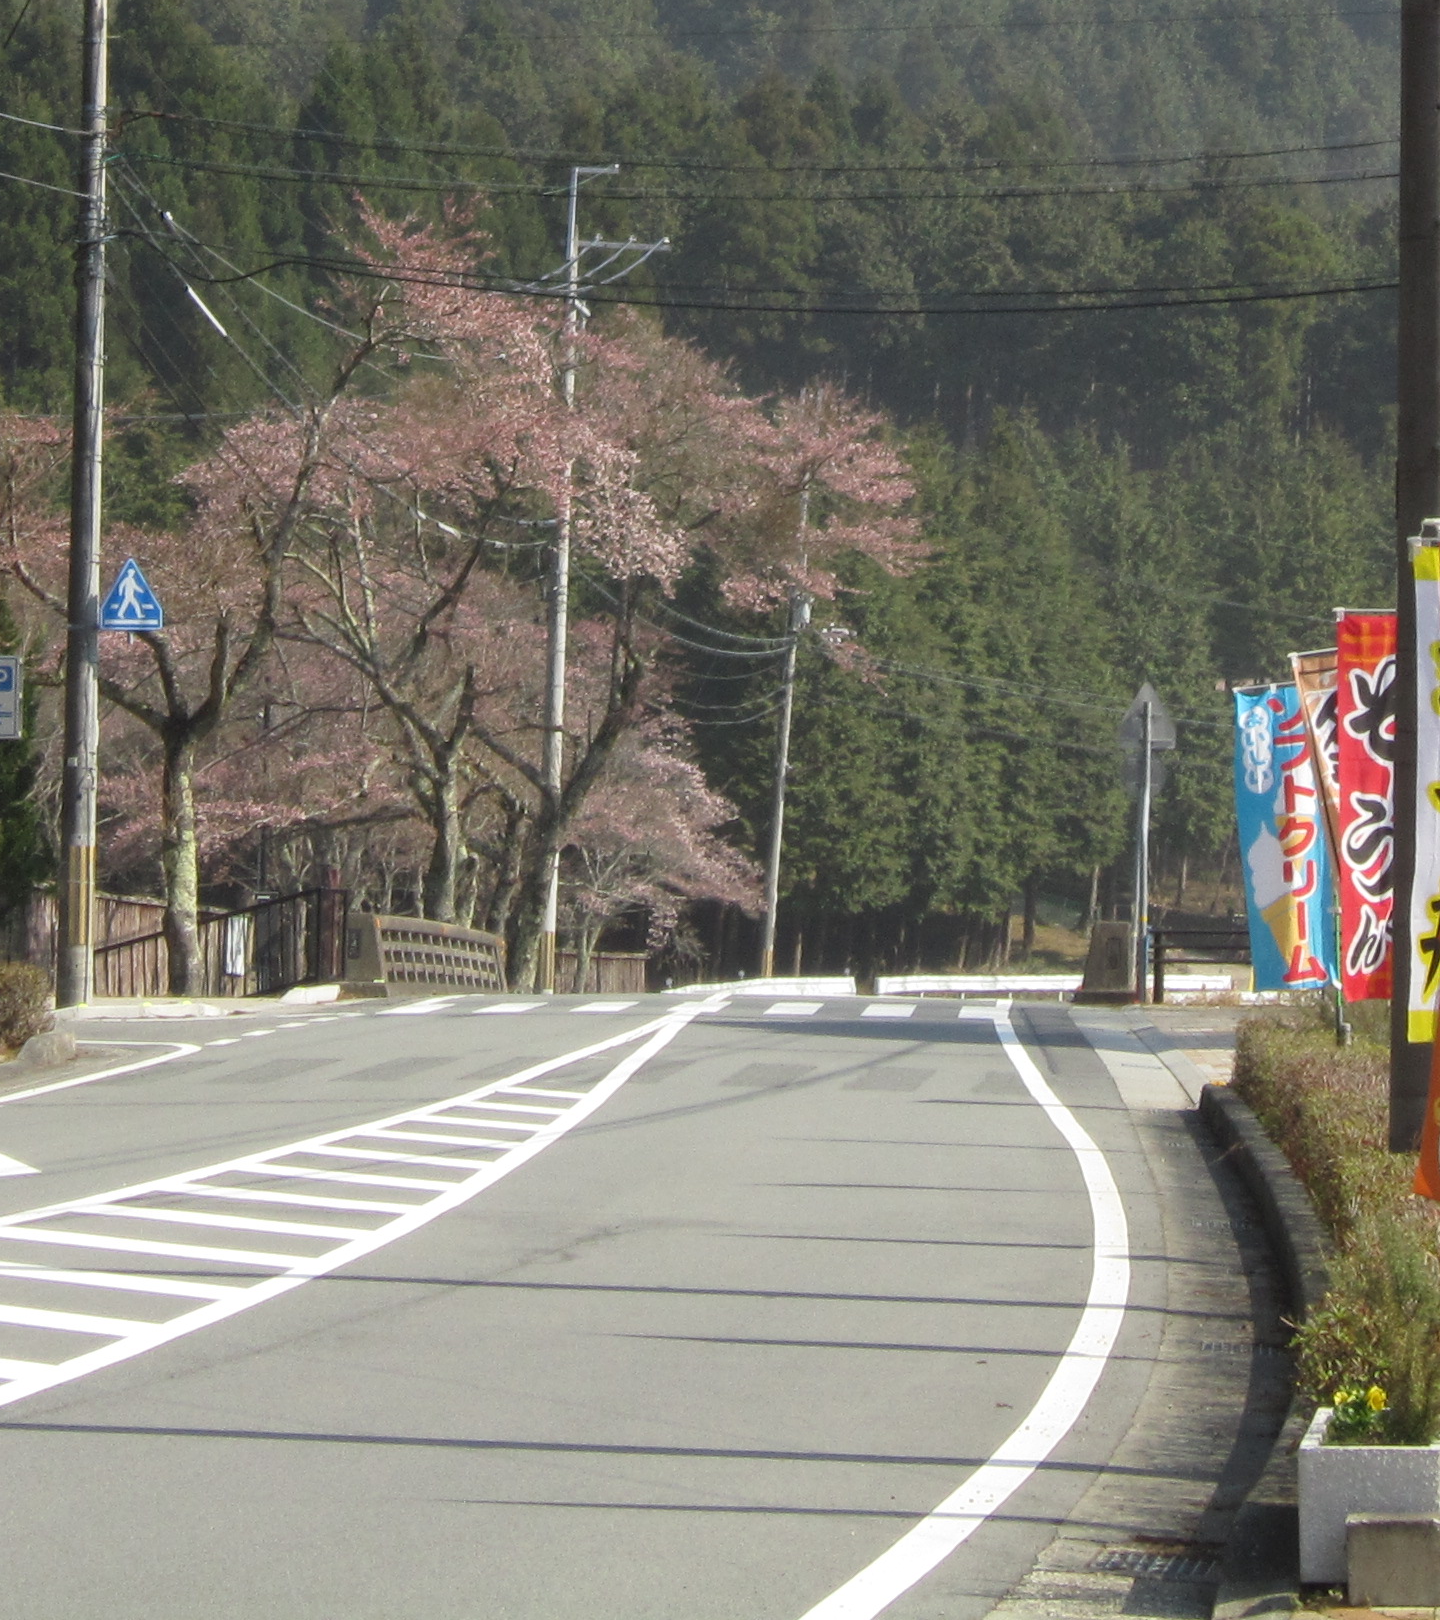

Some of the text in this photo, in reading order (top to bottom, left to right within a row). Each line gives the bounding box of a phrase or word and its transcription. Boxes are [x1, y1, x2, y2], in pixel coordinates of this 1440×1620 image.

[1265, 696, 1328, 984] ソフトクリーム
